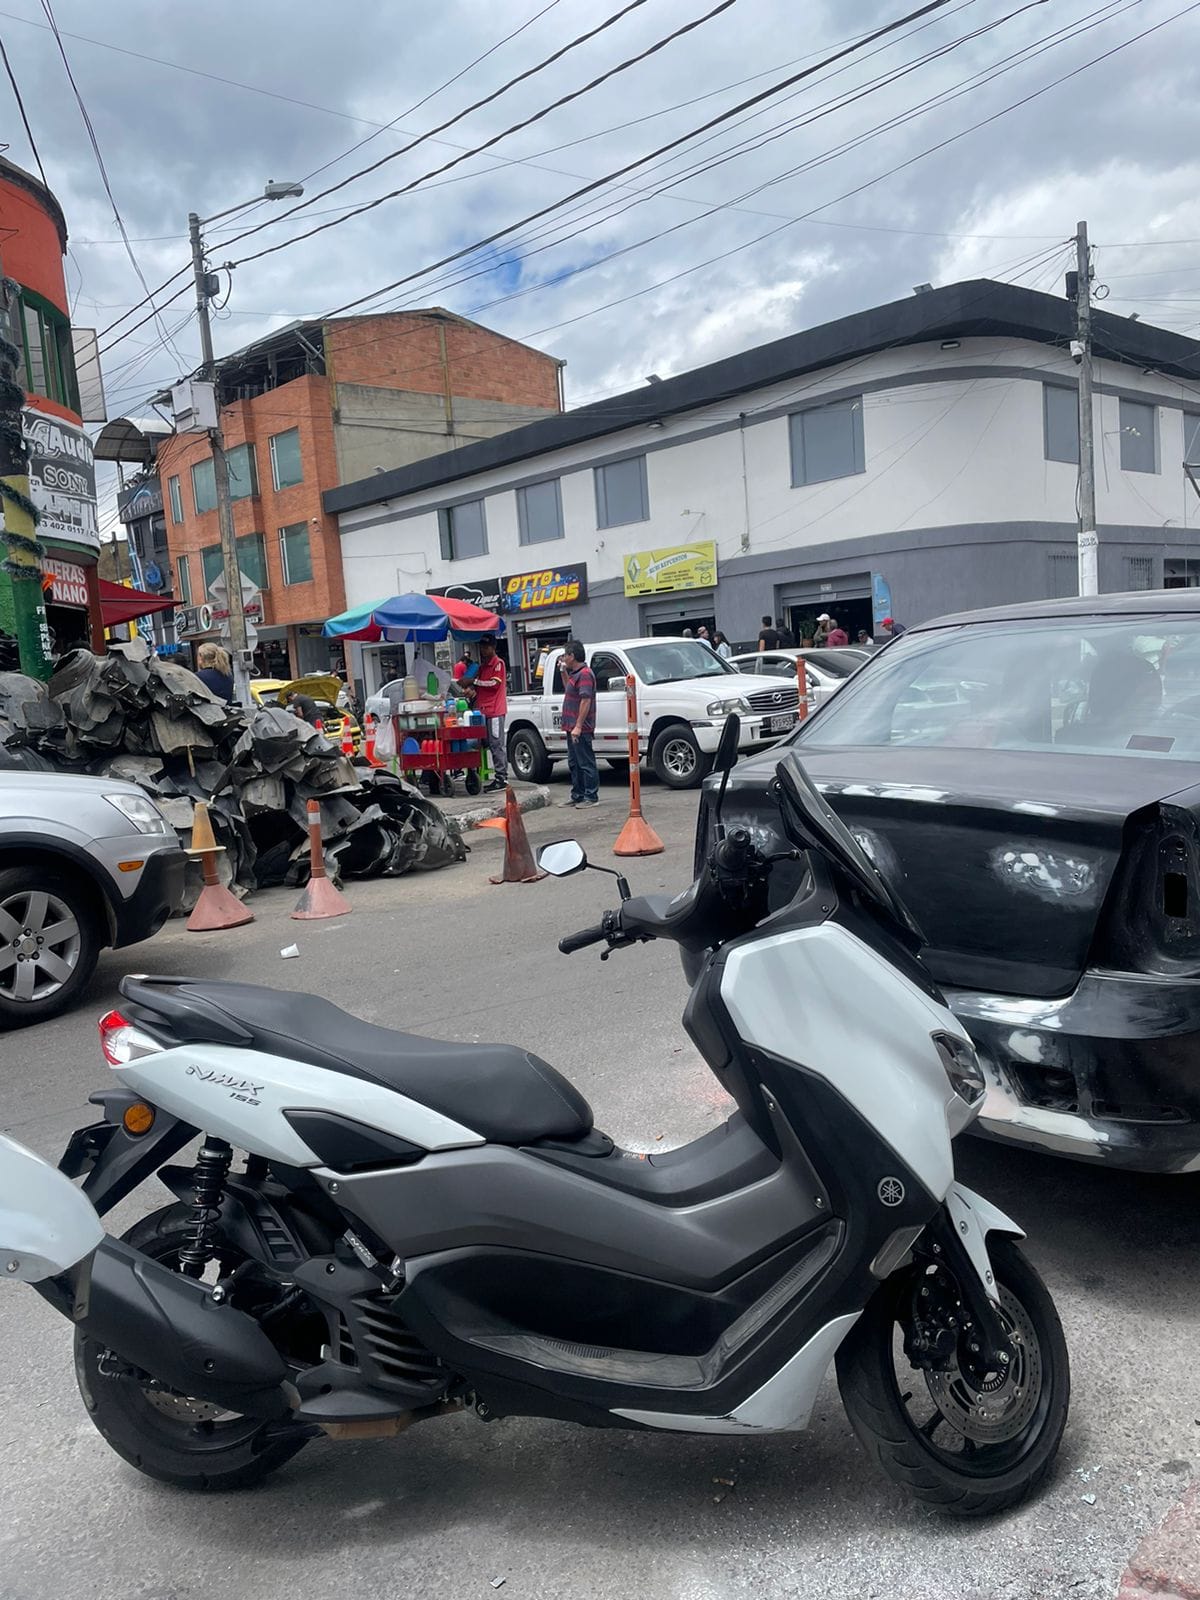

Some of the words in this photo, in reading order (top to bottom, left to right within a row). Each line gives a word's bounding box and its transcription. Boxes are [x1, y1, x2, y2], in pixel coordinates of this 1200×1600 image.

[43, 464, 88, 494] SONY
[50, 521, 66, 532] 402
[67, 523, 85, 535] 0117
[39, 558, 87, 585] MERAS
[506, 570, 554, 594] OTTO
[52, 582, 88, 605] NANO
[520, 582, 581, 610] LUJOS
[229, 1092, 262, 1106] 155
